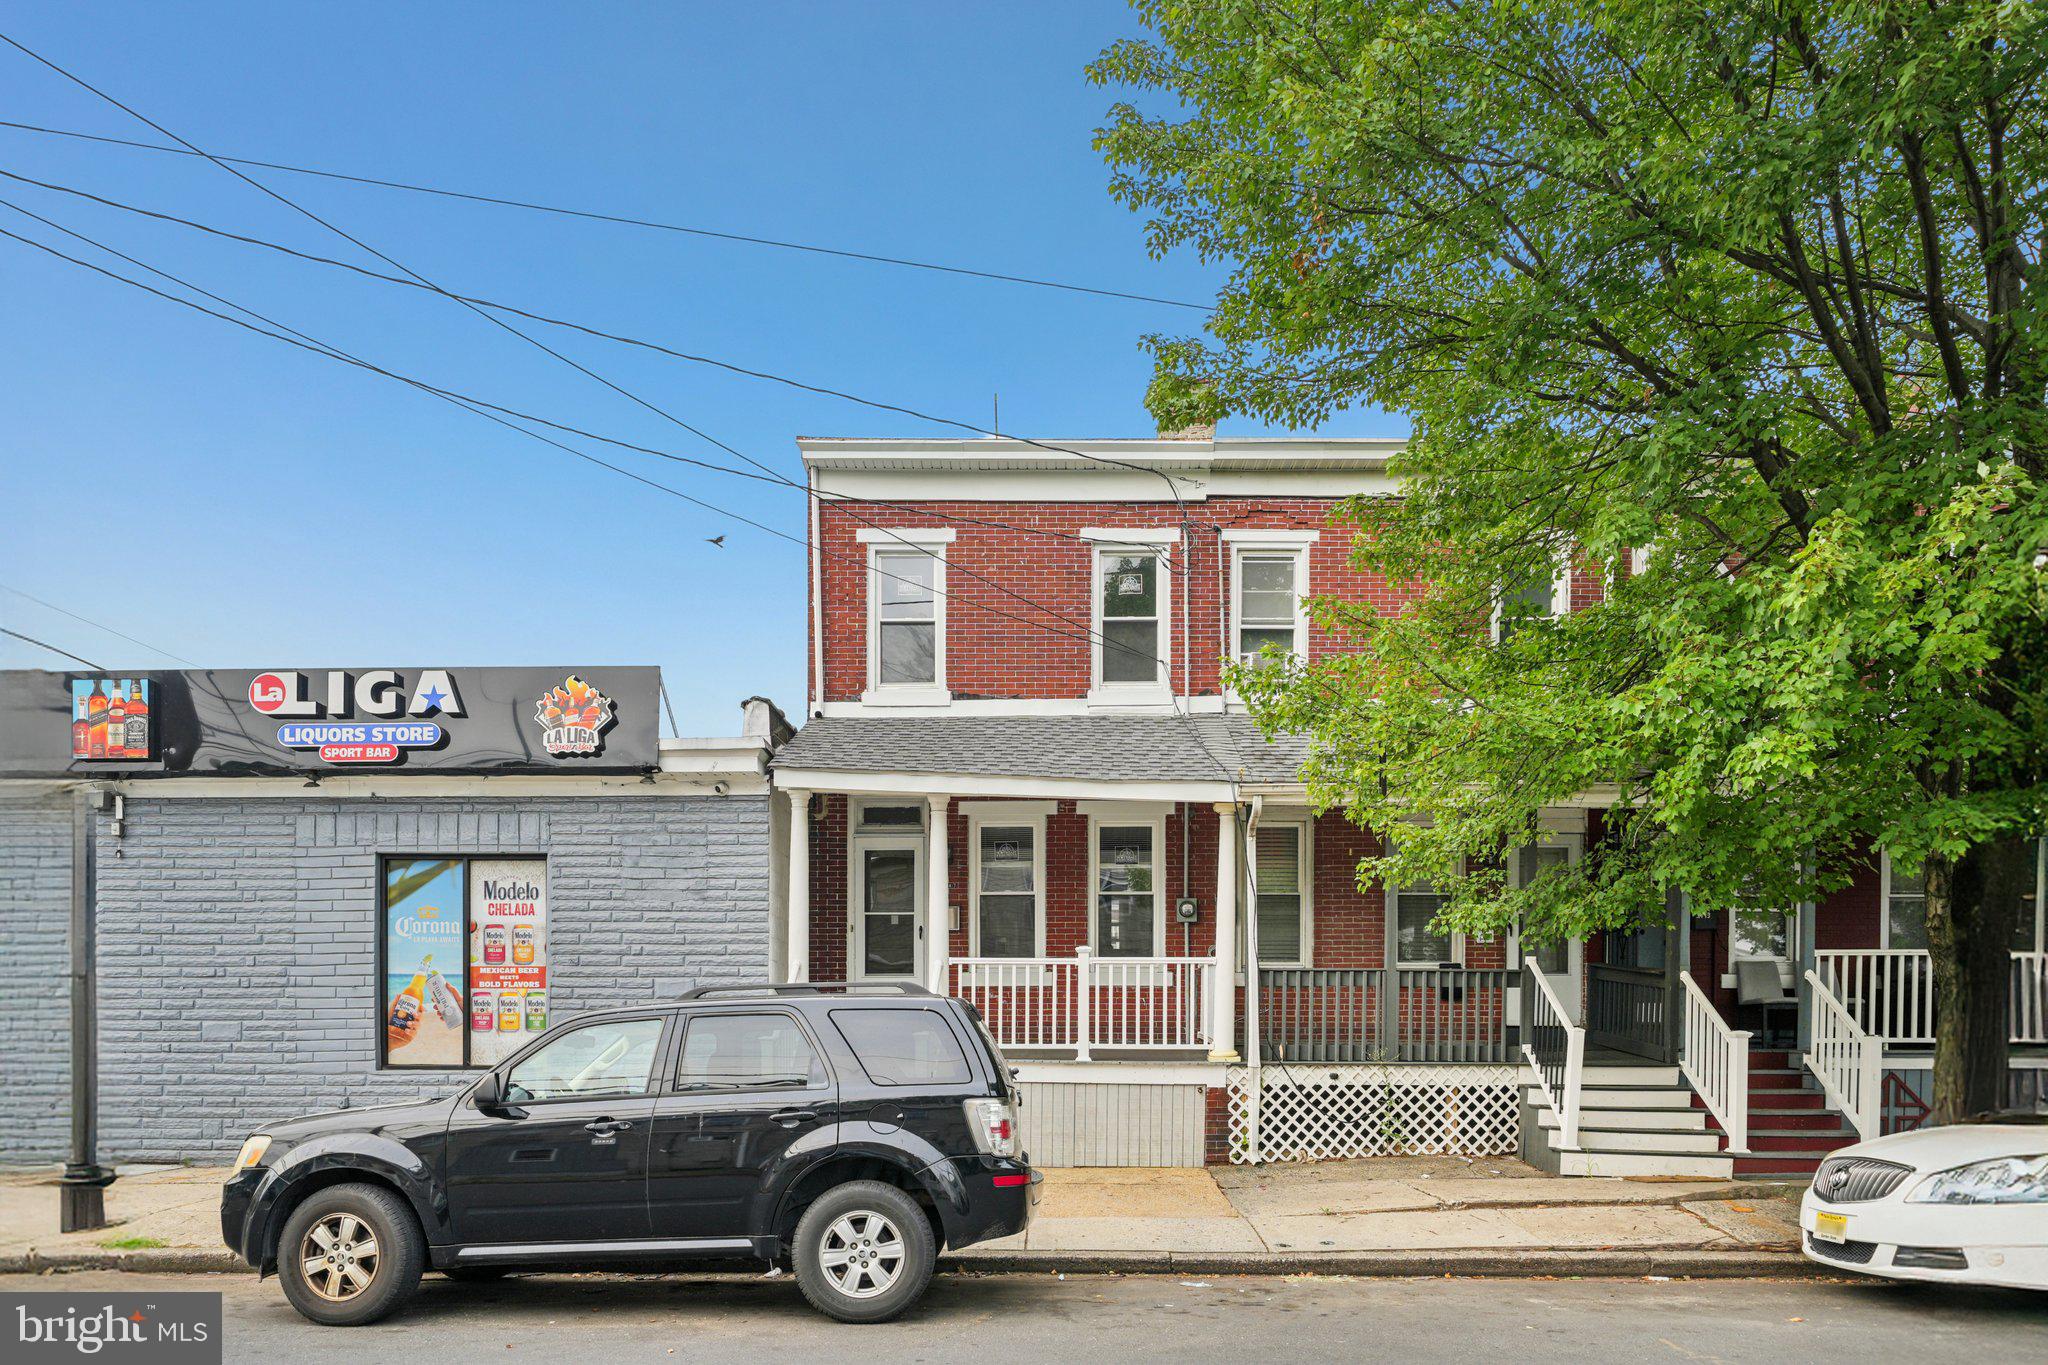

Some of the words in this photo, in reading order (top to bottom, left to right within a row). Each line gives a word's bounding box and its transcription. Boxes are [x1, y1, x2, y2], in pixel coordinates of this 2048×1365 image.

[249, 670, 460, 715] LIGA
[253, 682, 283, 702] La
[283, 727, 366, 744] LIQUORS
[372, 727, 434, 742] STORE
[547, 730, 563, 744] LA
[567, 727, 595, 744] LIGA
[324, 747, 363, 758] SPORT
[366, 747, 391, 757] BAR
[484, 880, 539, 900] Modelo
[487, 903, 535, 916] CHELADA
[394, 916, 460, 938] Corona
